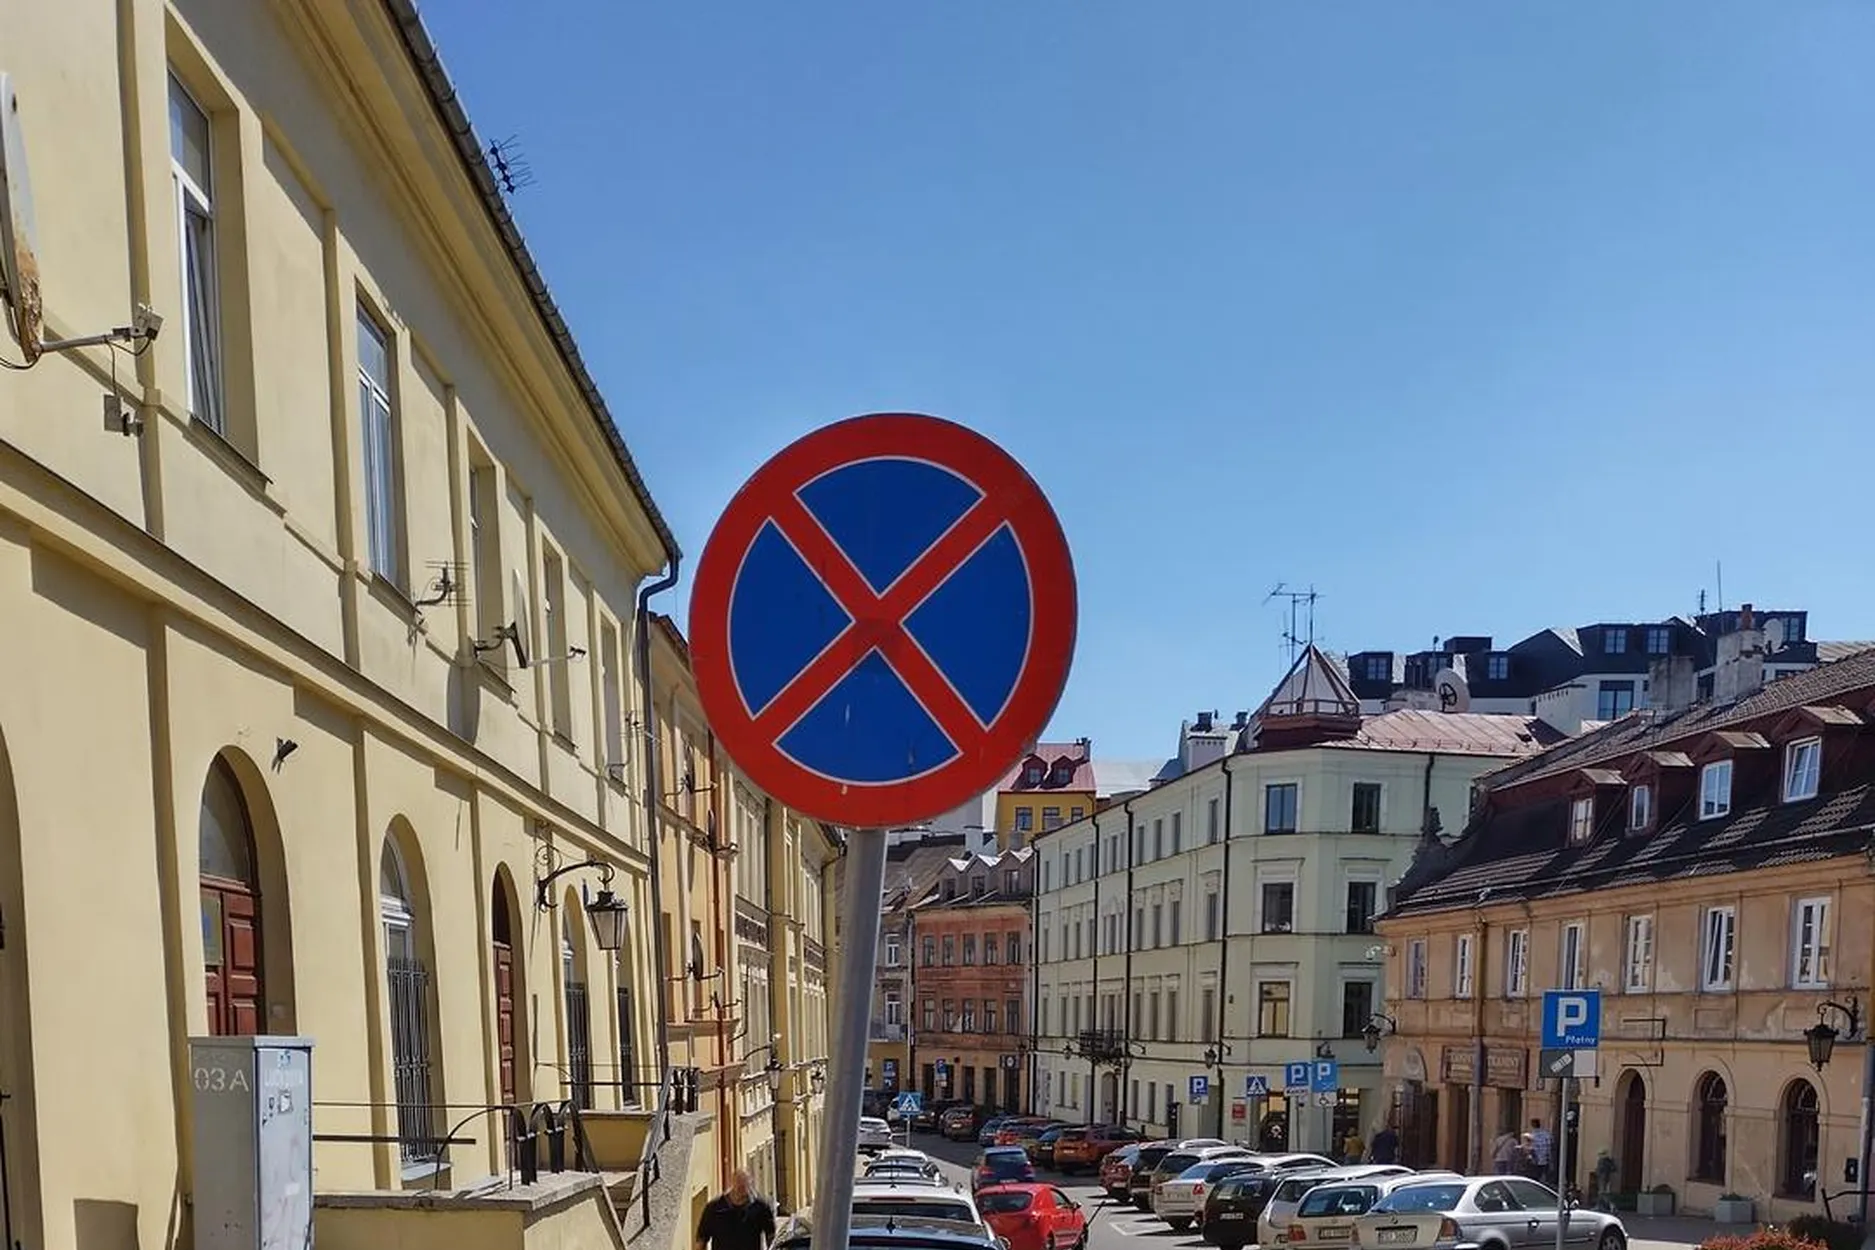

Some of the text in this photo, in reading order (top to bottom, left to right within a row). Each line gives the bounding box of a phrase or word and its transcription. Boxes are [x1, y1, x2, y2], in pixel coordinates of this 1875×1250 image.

[1557, 997, 1588, 1037] P
[1291, 1065, 1304, 1084] P
[1318, 1063, 1331, 1080] P
[1193, 1078, 1204, 1093] P
